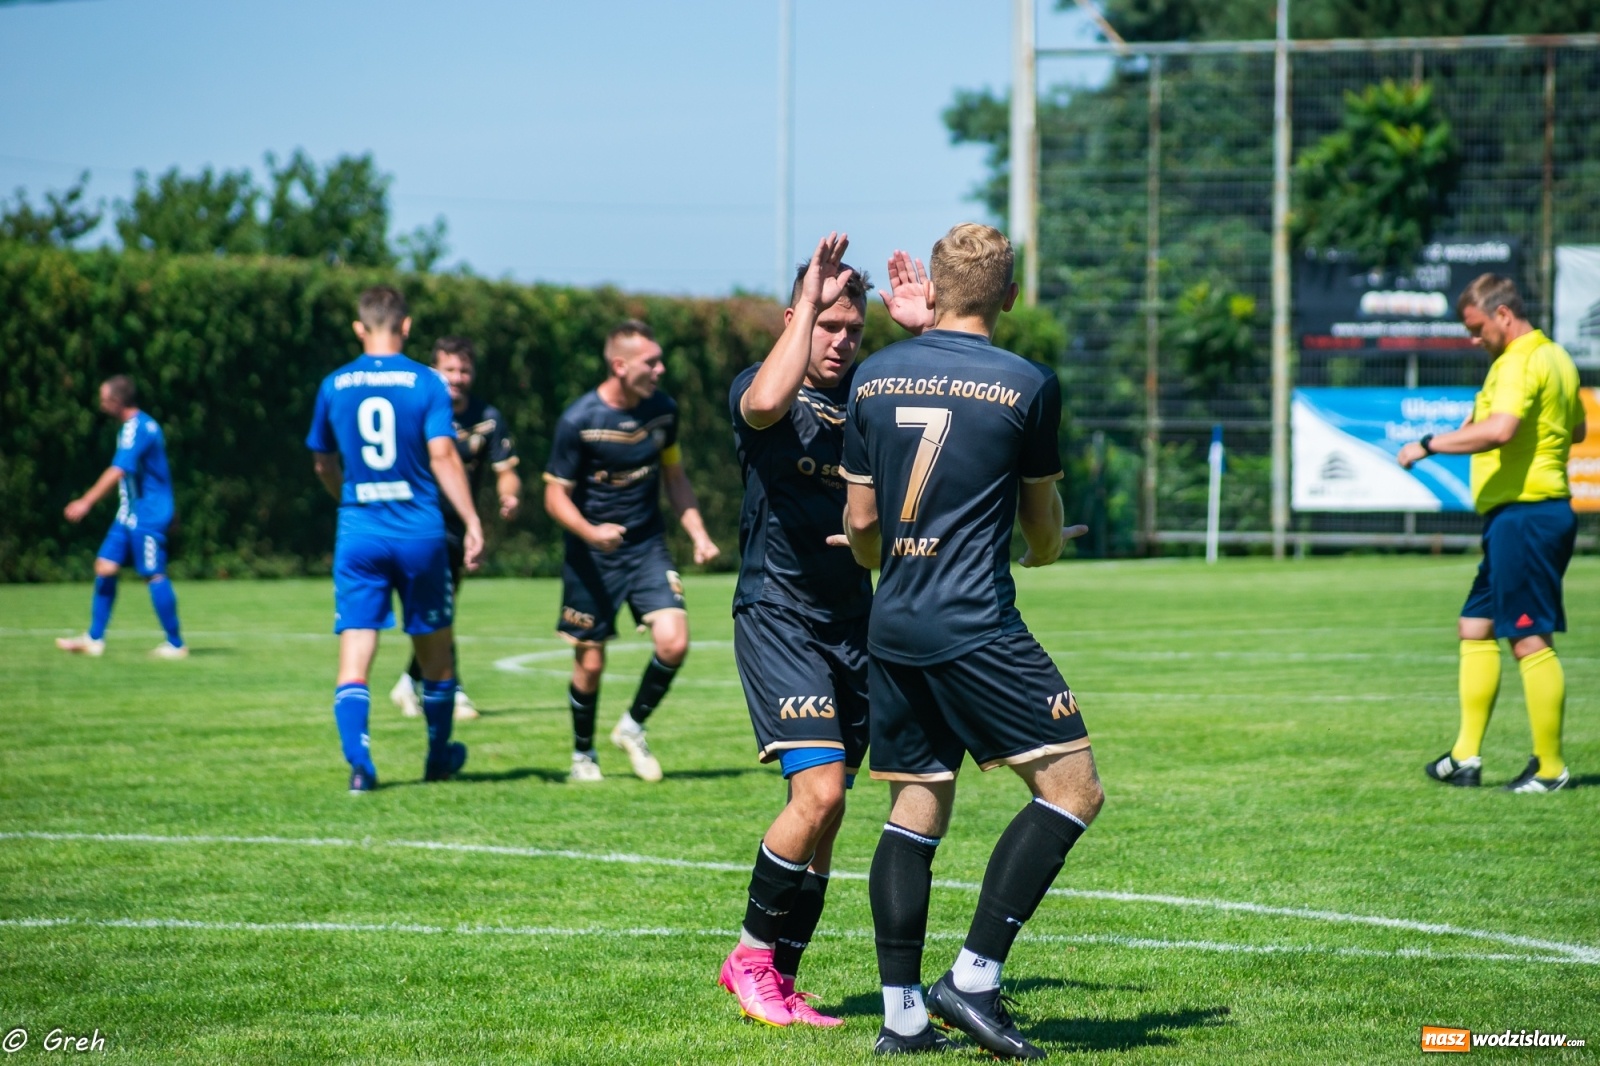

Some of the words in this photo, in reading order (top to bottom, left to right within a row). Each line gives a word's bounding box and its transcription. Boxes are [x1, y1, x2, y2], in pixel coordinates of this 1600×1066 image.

[855, 375, 949, 402] PRZYSZŁOŚĆ
[949, 381, 1022, 408] ROGÓW
[357, 396, 397, 471] 9
[895, 406, 952, 523] 7
[779, 695, 836, 720] KKS
